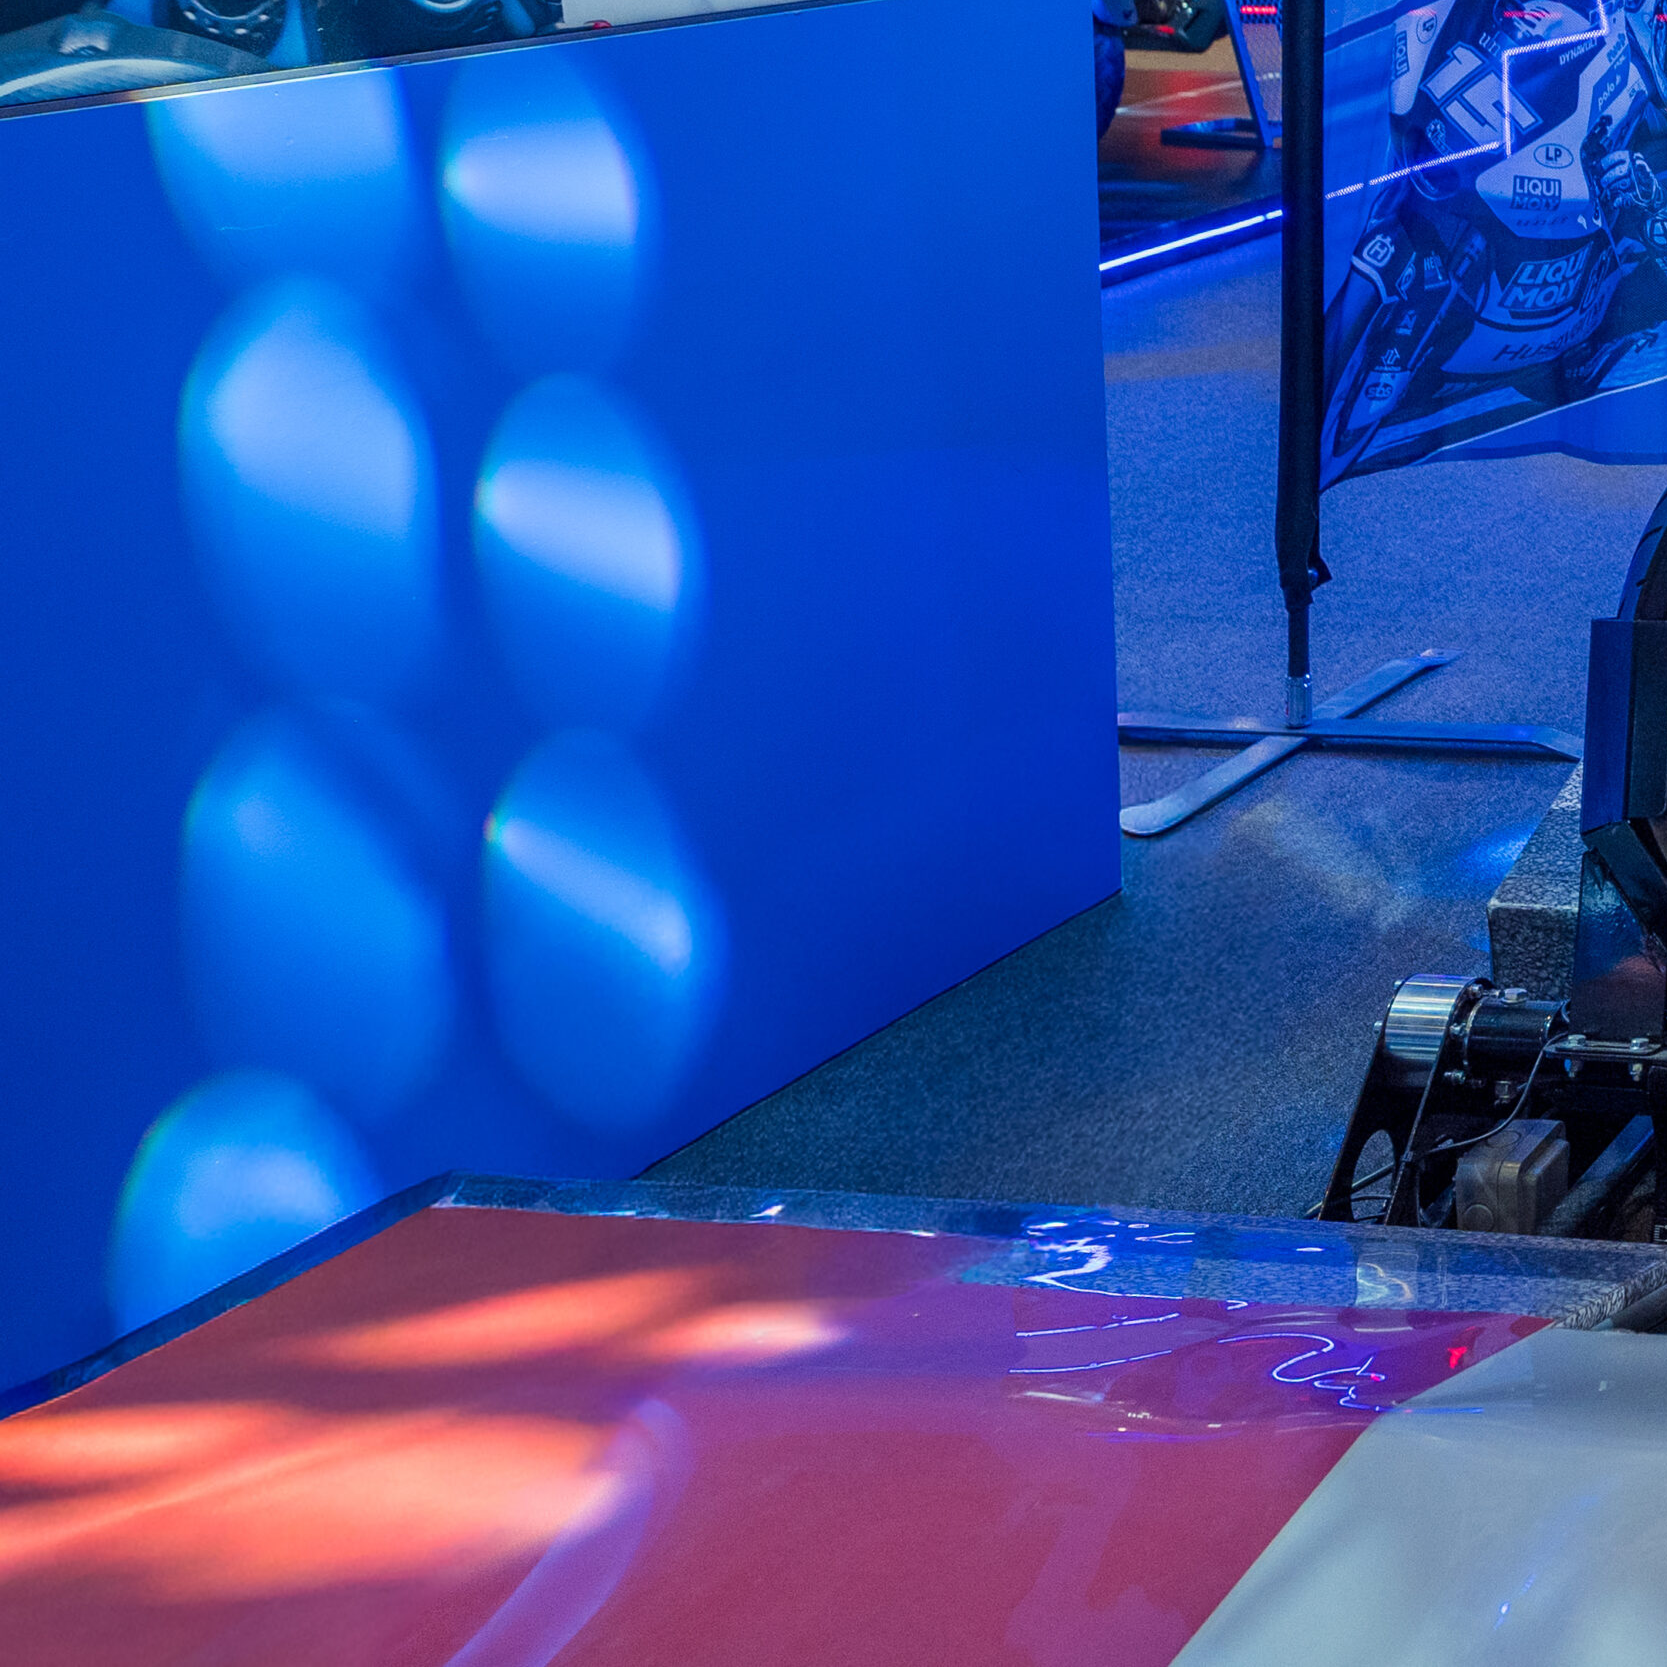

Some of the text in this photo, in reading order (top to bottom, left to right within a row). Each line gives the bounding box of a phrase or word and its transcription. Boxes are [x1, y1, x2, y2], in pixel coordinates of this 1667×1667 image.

[1515, 178, 1562, 196] LIQUI
[1513, 195, 1558, 211] MOLY
[1517, 253, 1588, 285] LIQUI
[1503, 284, 1577, 310] MOLY
